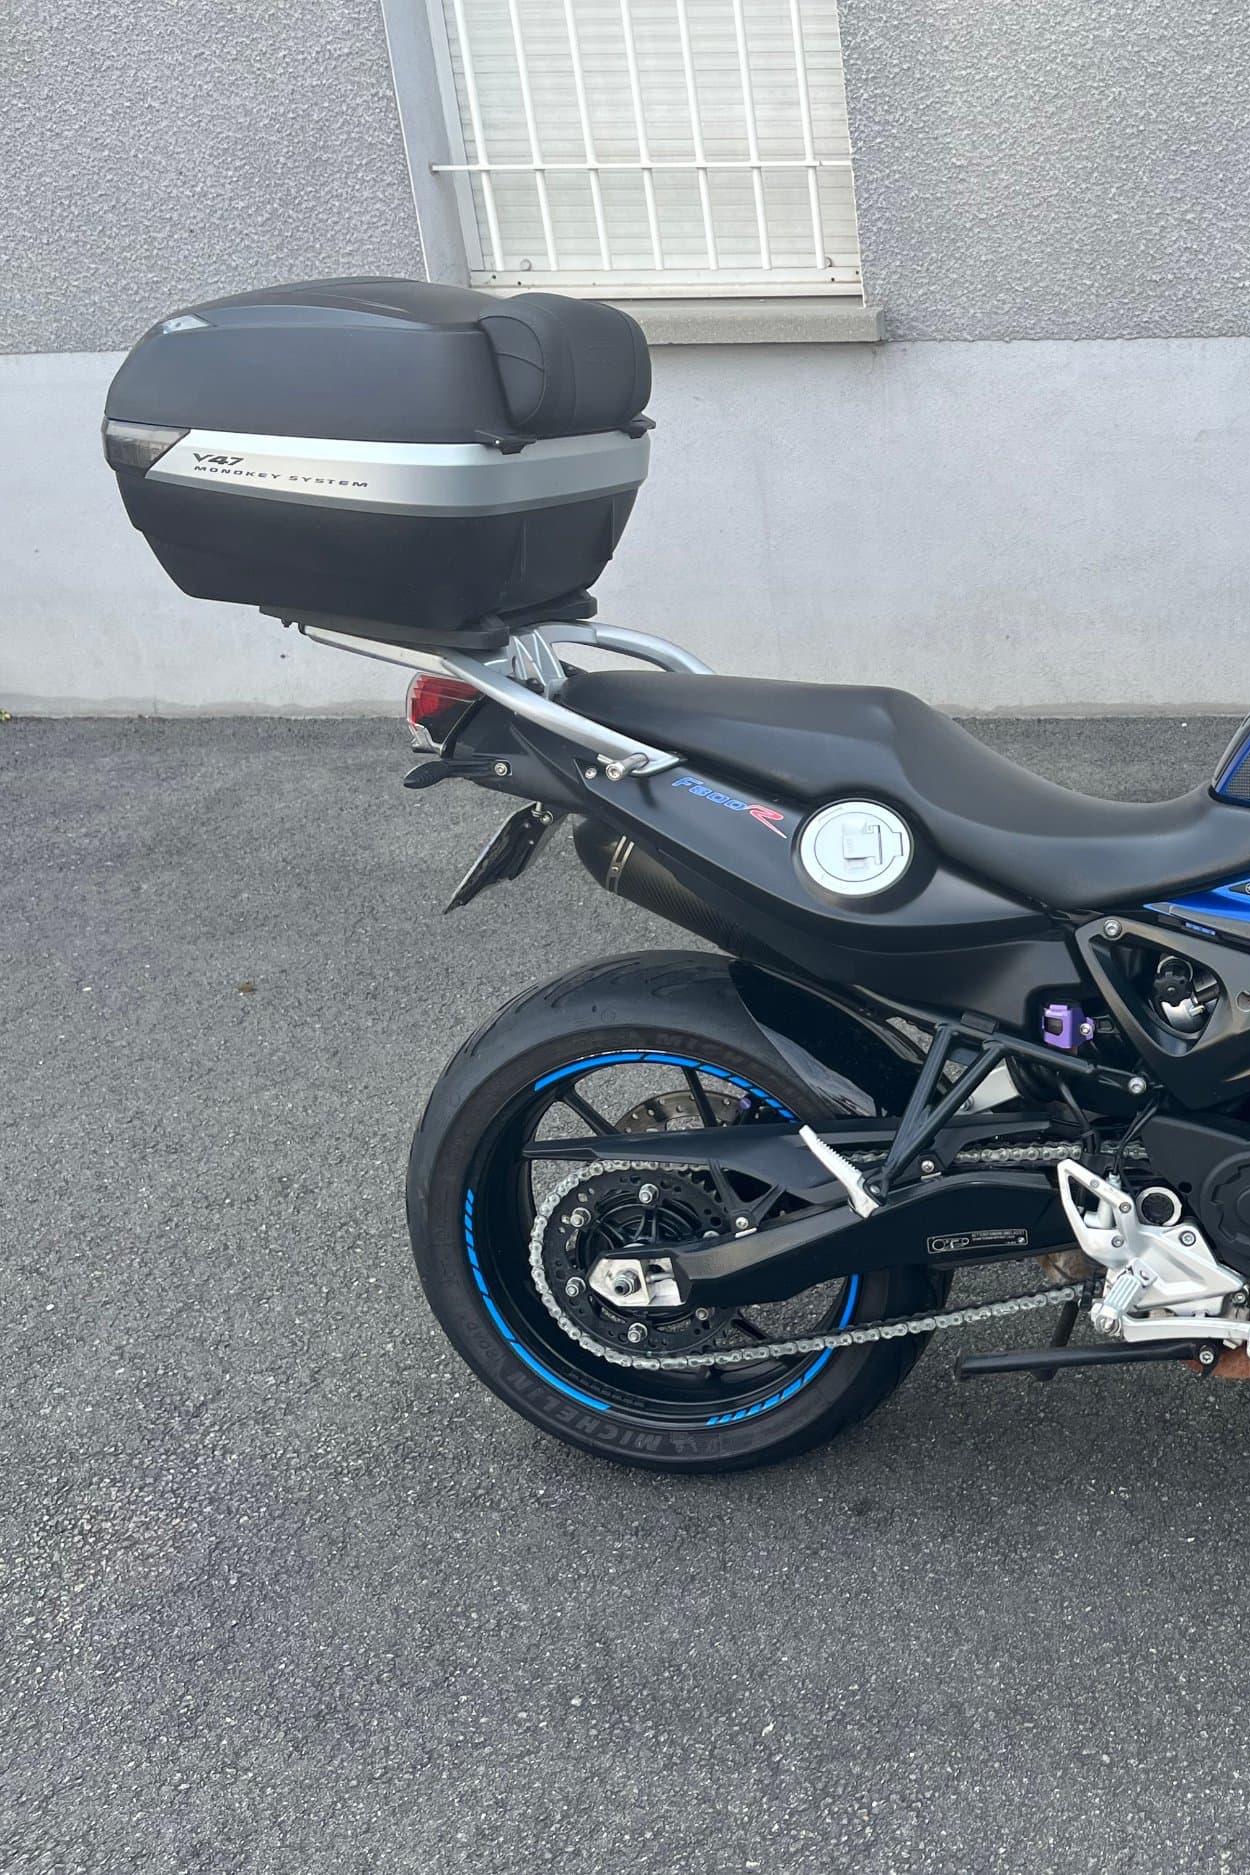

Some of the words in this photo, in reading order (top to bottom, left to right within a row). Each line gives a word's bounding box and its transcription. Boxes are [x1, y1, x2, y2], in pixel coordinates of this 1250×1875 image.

[193, 453, 245, 466] V47
[193, 465, 281, 480] MONOKEY
[288, 475, 368, 488] SYSTEM
[672, 776, 788, 839] F800R
[506, 1371, 664, 1451] MICHELIN
